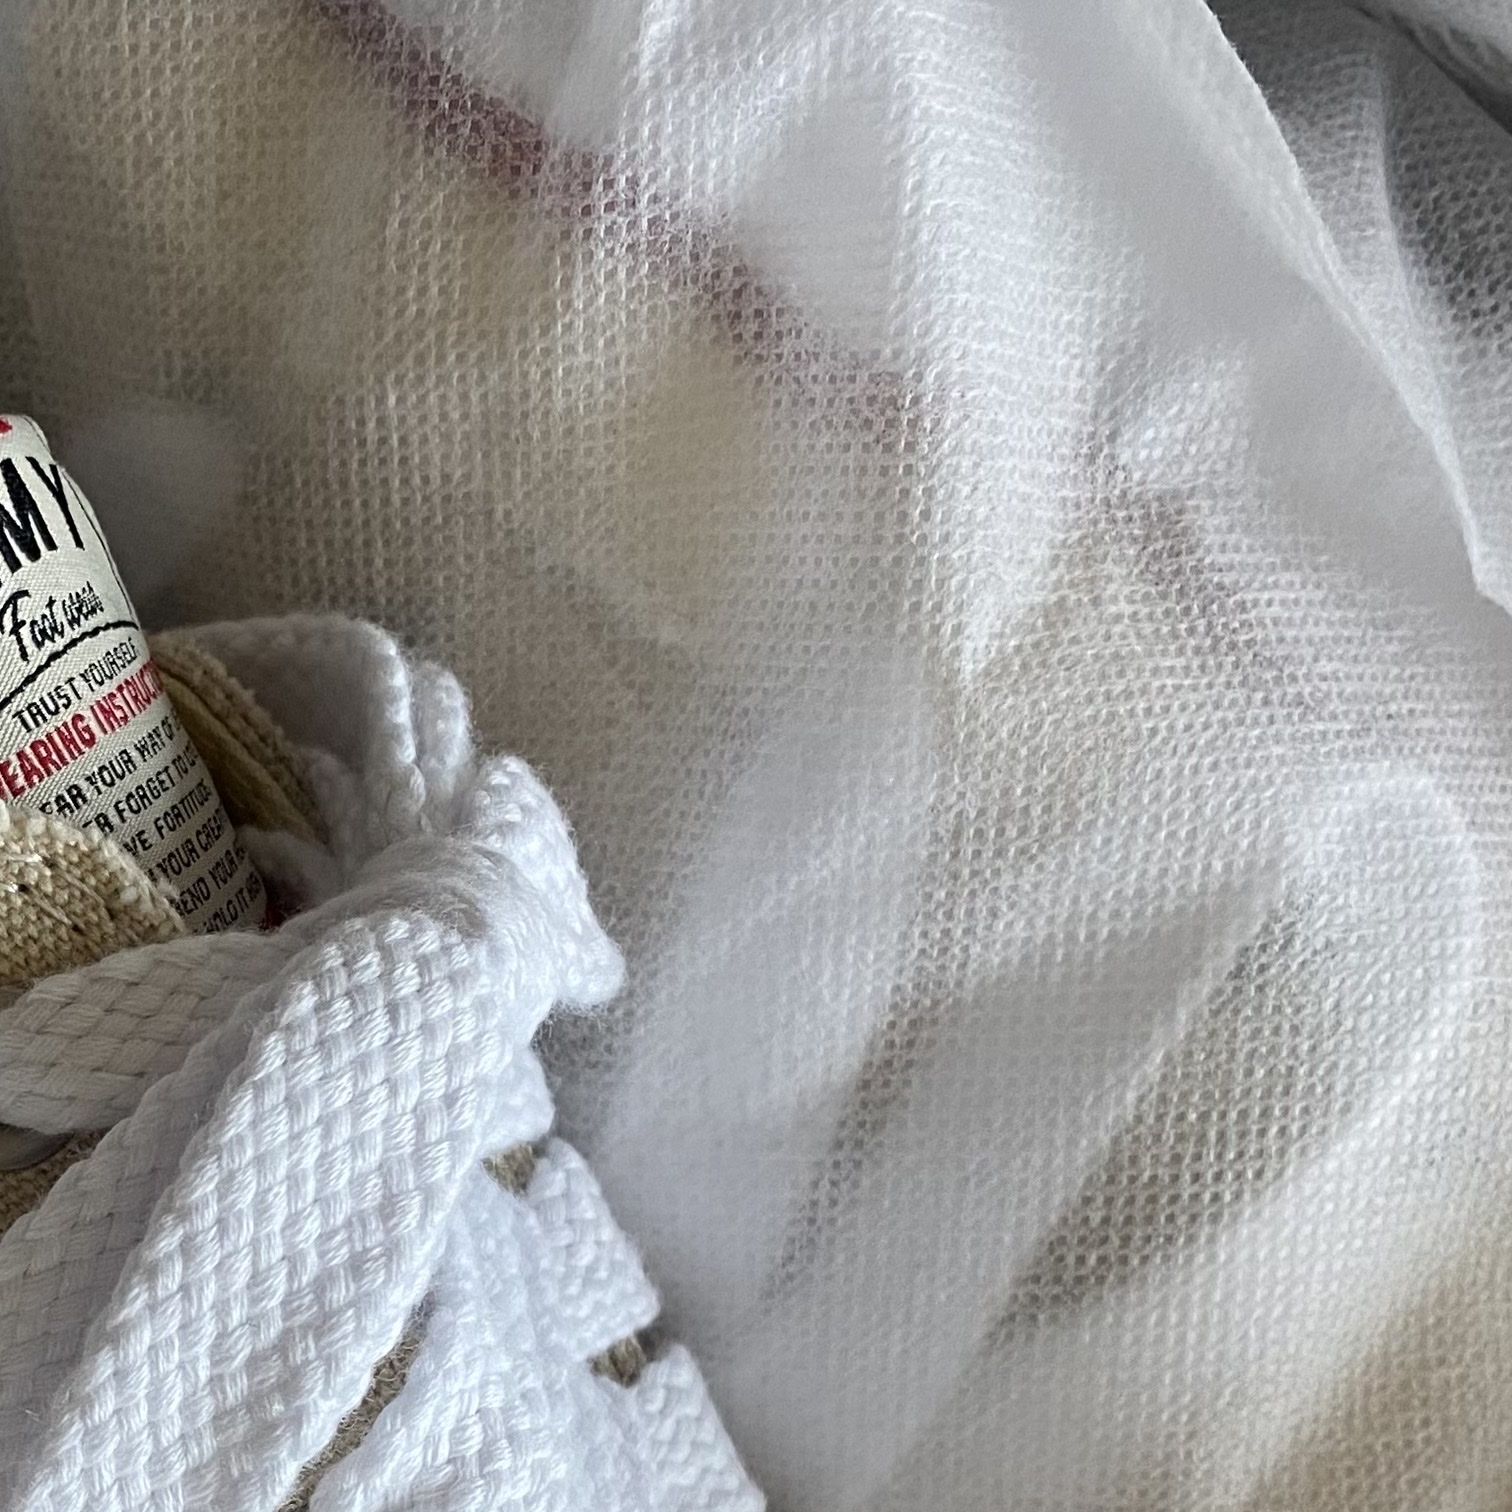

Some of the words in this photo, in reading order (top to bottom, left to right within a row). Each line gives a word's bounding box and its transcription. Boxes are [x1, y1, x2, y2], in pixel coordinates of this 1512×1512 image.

[12, 677, 82, 733] TRUST
[79, 637, 138, 692] YOURSELF
[39, 783, 88, 818] EAR
[85, 749, 138, 796] YOUR
[134, 726, 166, 762] WAY
[161, 716, 175, 741] OF
[113, 766, 176, 824] FORGET
[153, 779, 215, 840] FORTITUDE
[156, 838, 201, 882] YOUR
[196, 807, 226, 851] CREA
[209, 849, 239, 890] YOUR
